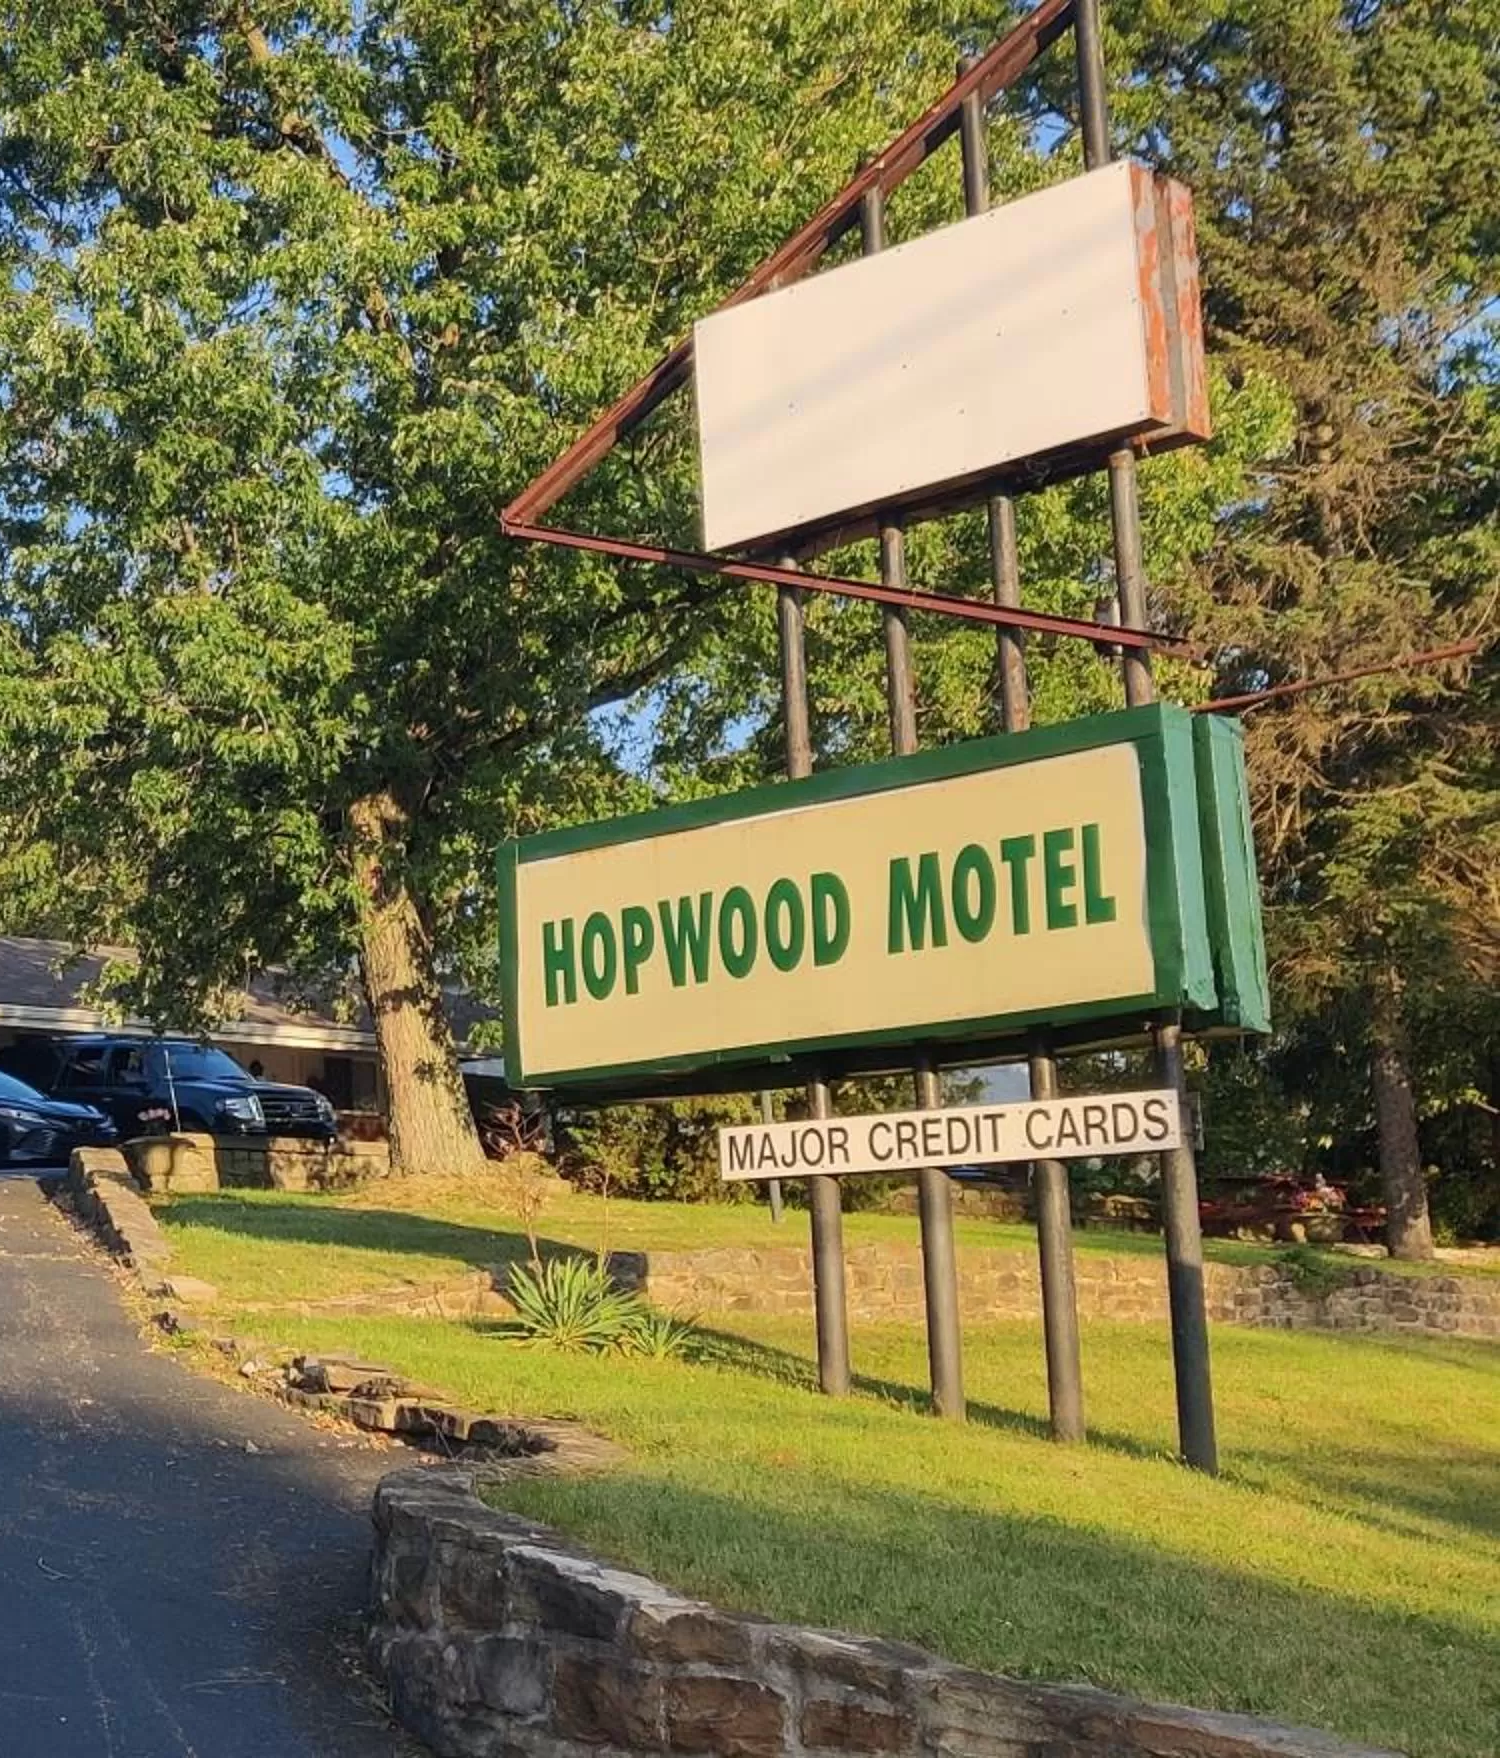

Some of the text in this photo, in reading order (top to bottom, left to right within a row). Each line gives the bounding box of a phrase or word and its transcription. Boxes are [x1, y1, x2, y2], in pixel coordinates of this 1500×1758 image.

[542, 823, 1117, 1008] HOPWOOD MOTEL
[727, 1099, 1169, 1171] MAJOR CREDIT CARDS
